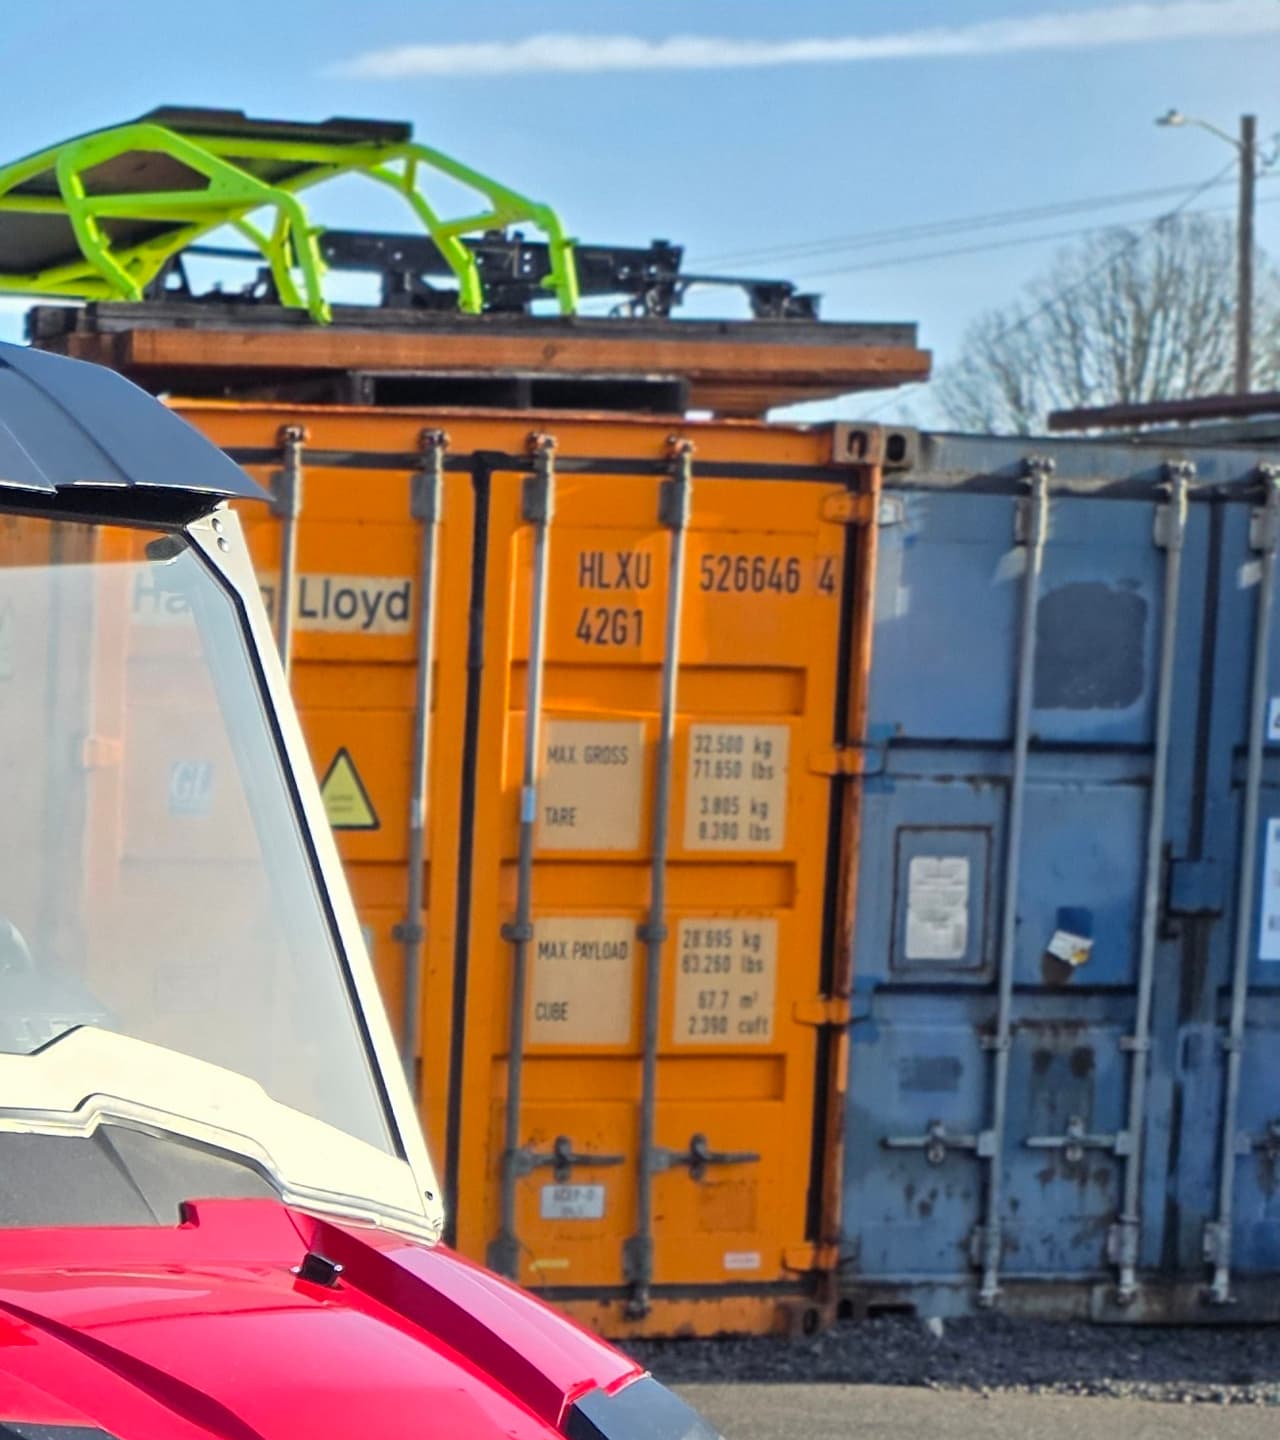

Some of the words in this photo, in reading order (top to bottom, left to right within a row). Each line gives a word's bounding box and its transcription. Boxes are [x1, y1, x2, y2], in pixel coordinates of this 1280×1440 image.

[578, 552, 652, 590] HLXU
[699, 554, 801, 594] 526646
[817, 559, 836, 596] 4
[298, 577, 412, 630] Lloyd
[576, 607, 644, 647] 42G1
[583, 745, 629, 766] GROSS
[754, 736, 772, 759] kg
[752, 761, 774, 780] lbs
[545, 806, 576, 827] TARE
[750, 798, 769, 821] kg
[748, 823, 771, 842] lbs
[572, 941, 628, 960] PAYLOAD
[742, 930, 761, 953] kg
[742, 955, 764, 974] lbs
[536, 1001, 569, 1021] CUBE
